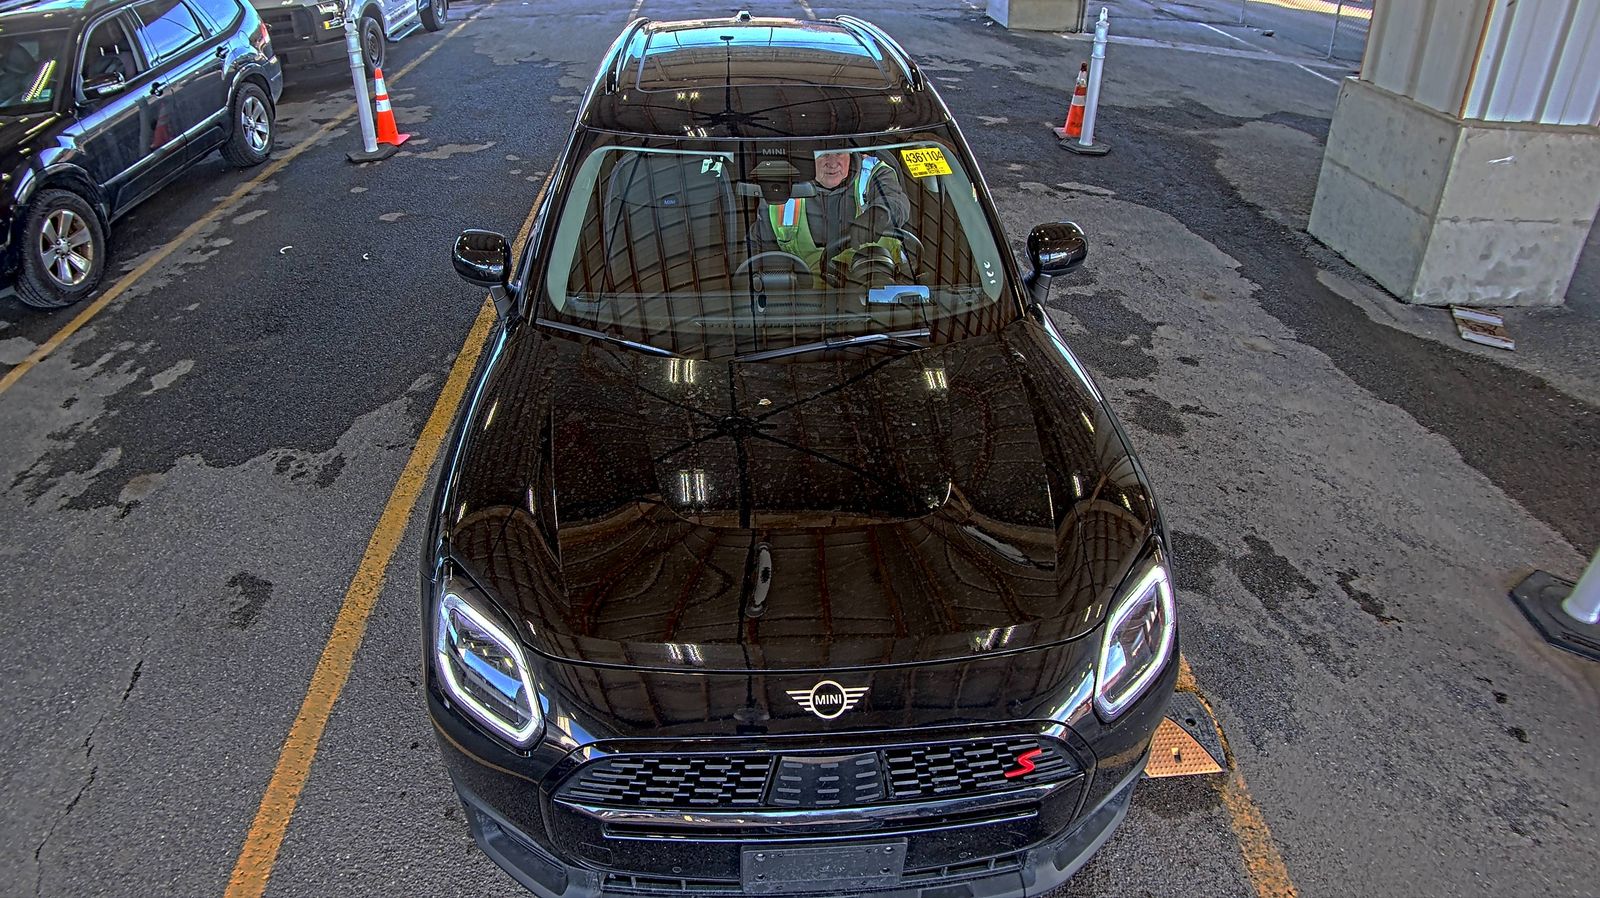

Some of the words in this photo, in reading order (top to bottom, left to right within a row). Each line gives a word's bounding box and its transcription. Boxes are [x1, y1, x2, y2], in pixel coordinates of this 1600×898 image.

[905, 151, 944, 163] 4361104
[814, 694, 842, 705] MINI
[1004, 748, 1042, 778] S
